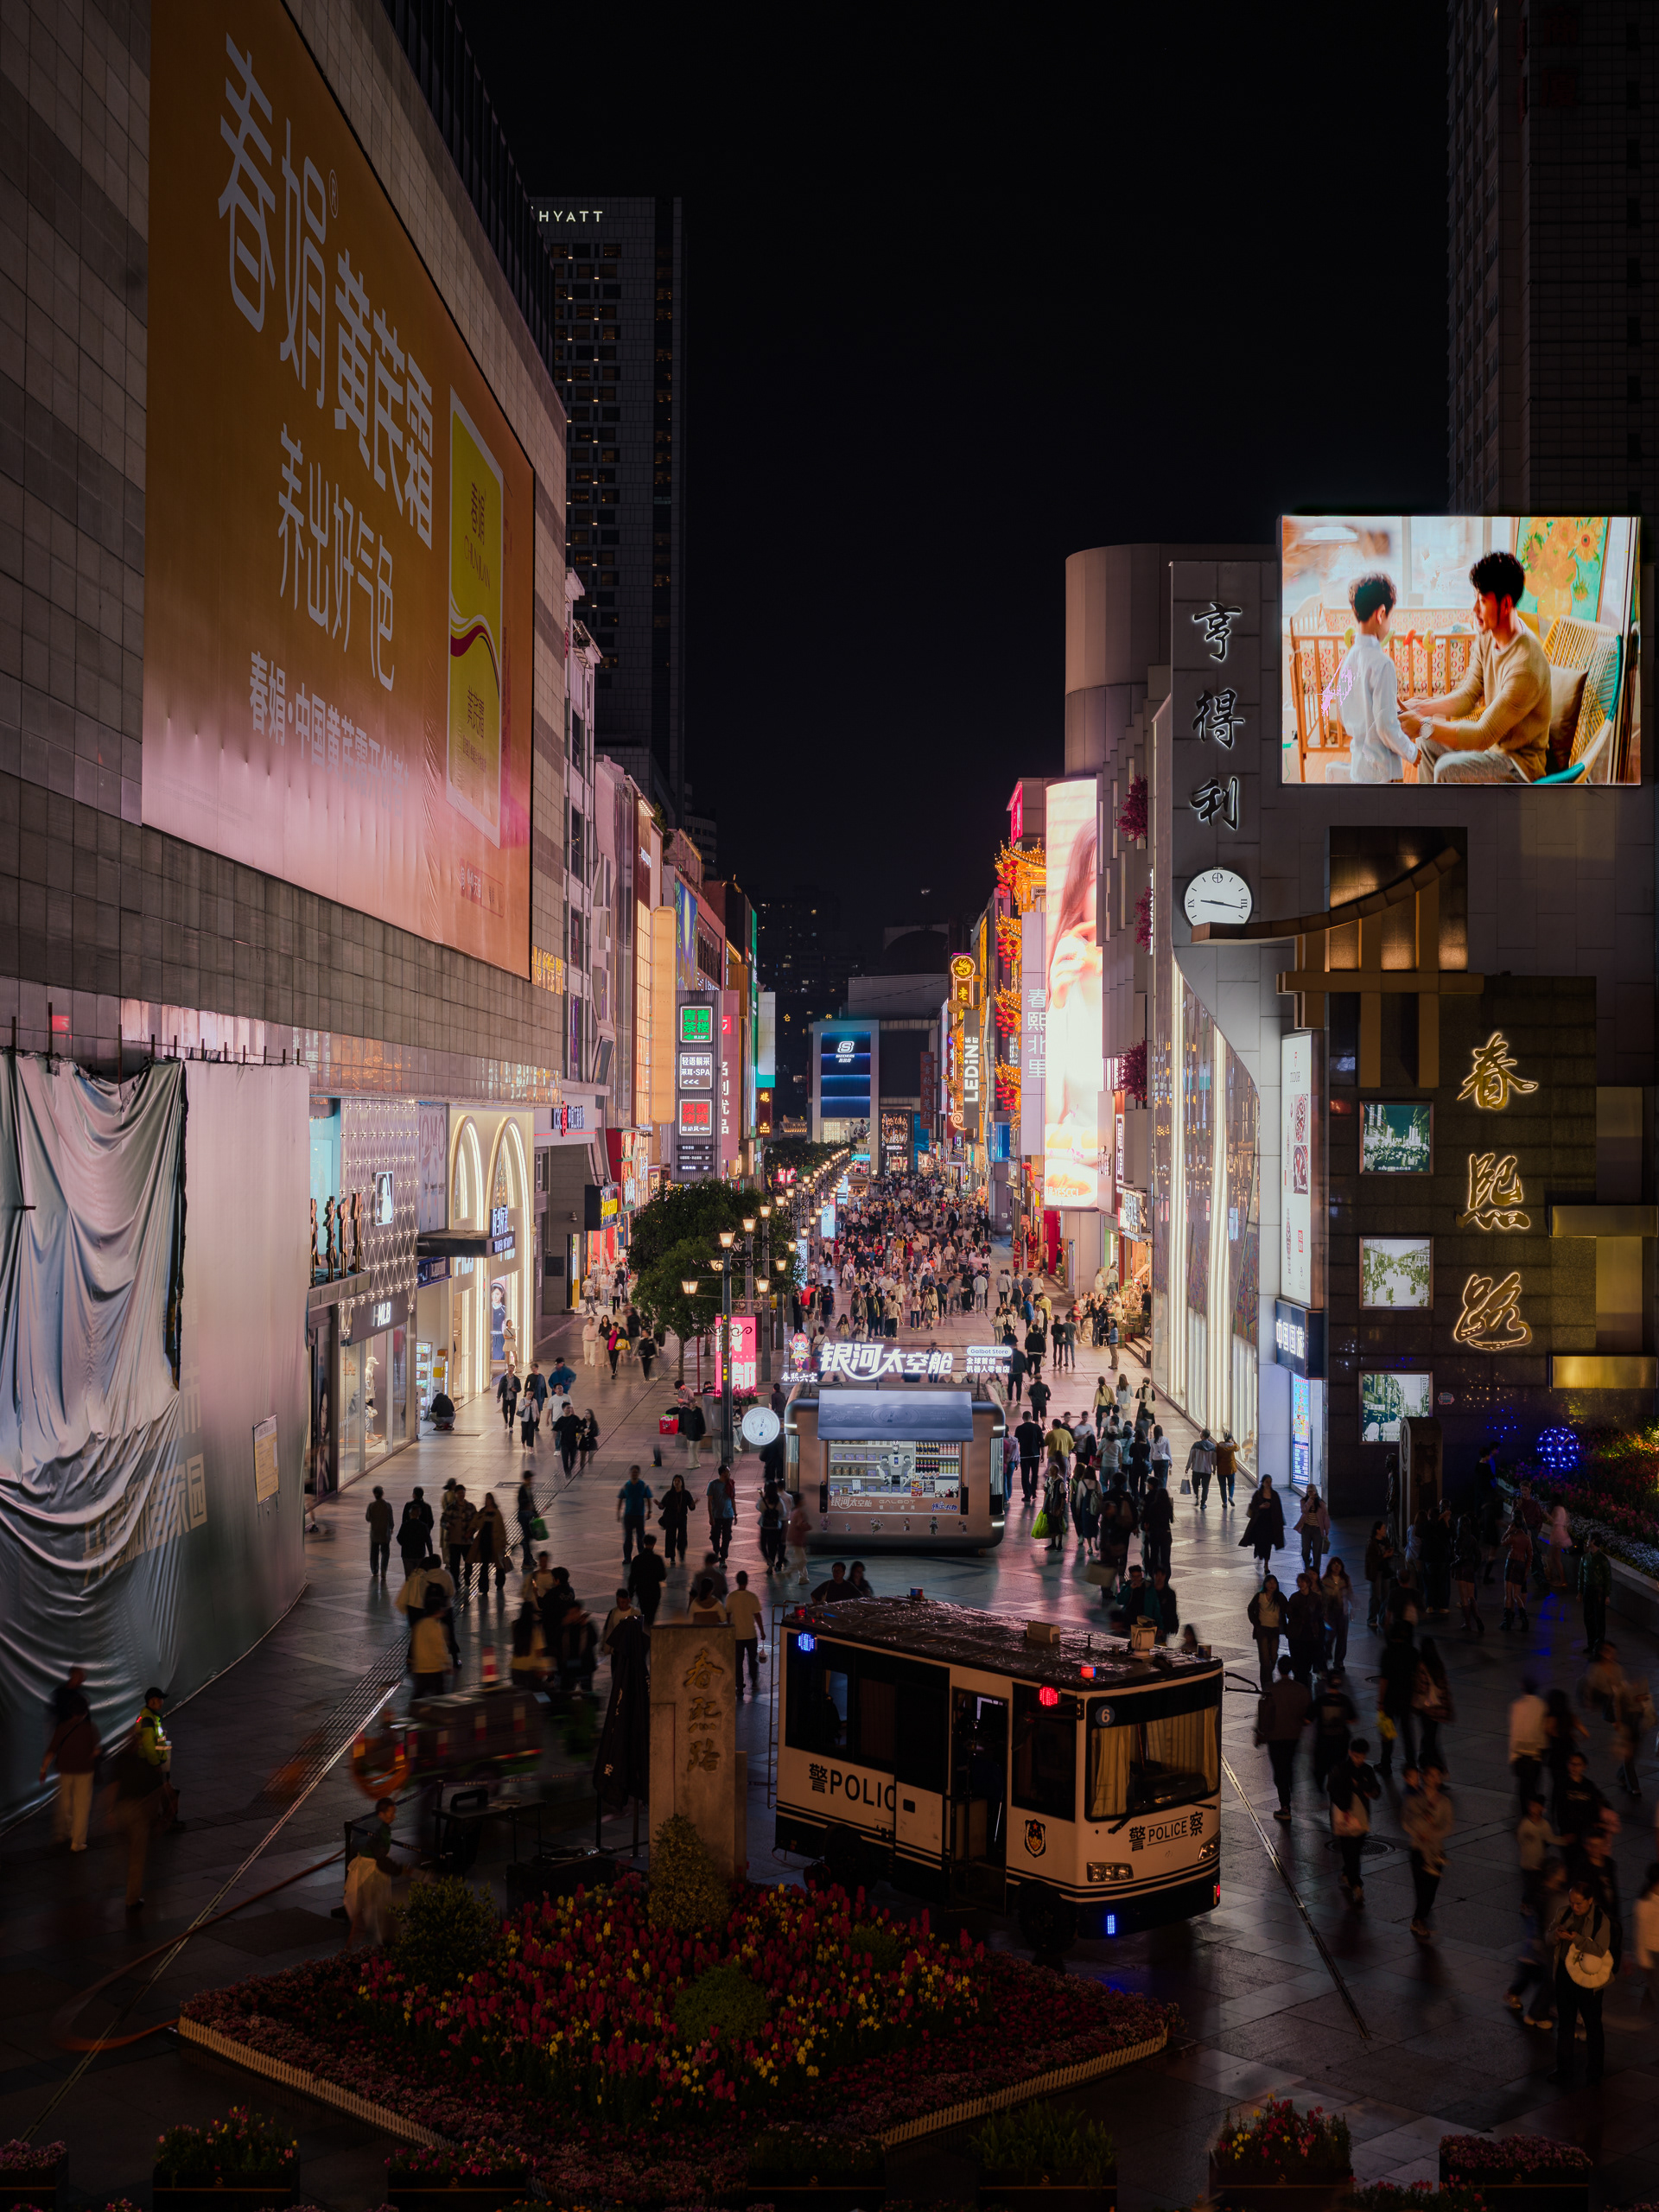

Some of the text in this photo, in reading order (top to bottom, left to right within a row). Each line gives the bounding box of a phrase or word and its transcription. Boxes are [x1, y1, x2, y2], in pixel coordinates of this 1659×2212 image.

[538, 210, 604, 223] HYATT
[278, 423, 396, 692] 养出好气色
[1190, 601, 1244, 831] 亨得利
[1454, 1031, 1539, 1352] 春熙路
[378, 1301, 391, 1327] MLB
[819, 1342, 954, 1381] 银河太空舱
[830, 1497, 873, 1510] 银河太空舱
[683, 1648, 724, 1771] 春熙路
[1100, 1706, 1111, 1723] 6
[808, 1763, 828, 1795] 警
[1129, 1811, 1204, 1852] 警 POLICE 察
